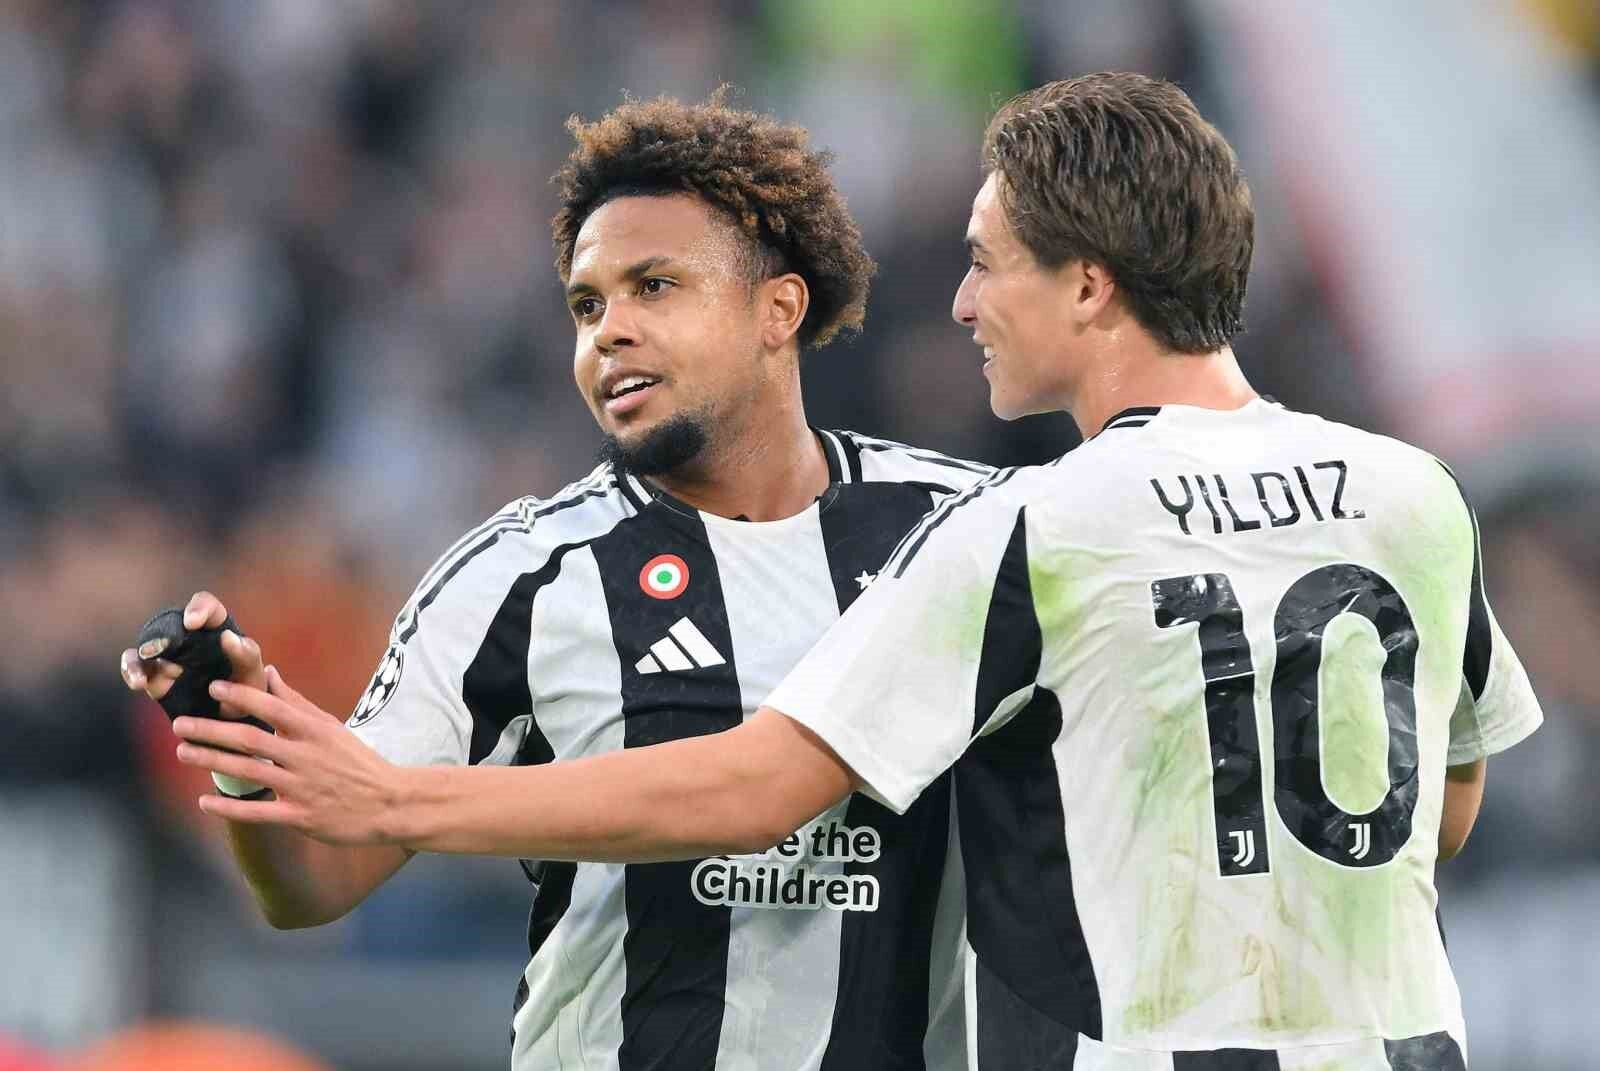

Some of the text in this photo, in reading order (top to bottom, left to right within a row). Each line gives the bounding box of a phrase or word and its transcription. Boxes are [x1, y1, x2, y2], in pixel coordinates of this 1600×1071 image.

[1150, 460, 1366, 536] YILDIZ
[1151, 563, 1419, 877] 10
[811, 822, 875, 857] the
[696, 863, 875, 906] Children
